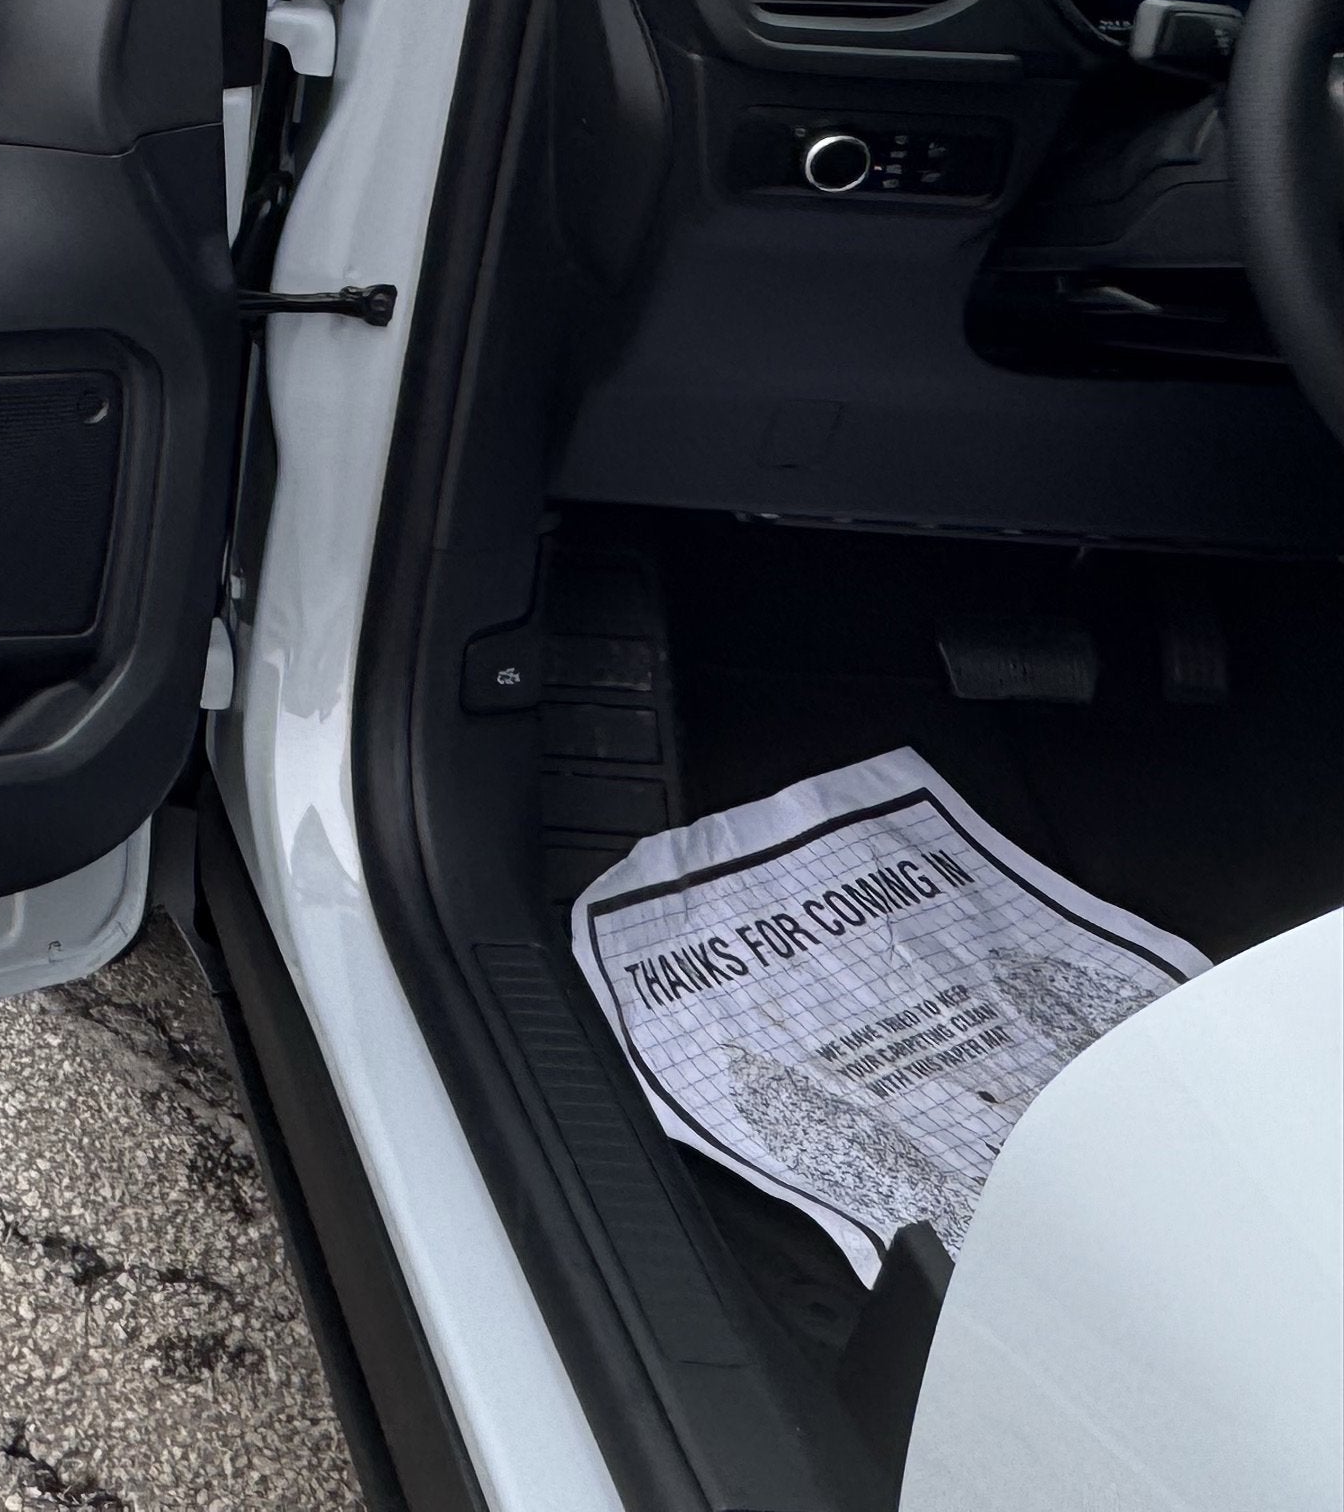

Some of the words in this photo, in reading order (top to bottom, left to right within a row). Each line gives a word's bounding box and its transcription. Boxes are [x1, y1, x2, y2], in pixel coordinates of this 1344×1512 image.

[624, 937, 749, 1010] THANKS
[735, 912, 821, 967] FOR
[802, 859, 944, 937] COMING
[921, 849, 975, 888] IN
[815, 1040, 847, 1063] WE
[839, 1024, 881, 1049] HAVE
[876, 1009, 922, 1034] TRIED
[913, 999, 942, 1019] TO
[836, 1054, 885, 1082] YOUR
[876, 1023, 953, 1063] CARPETING
[950, 1002, 999, 1033] CLEAN
[865, 1068, 913, 1100] WITH
[904, 1056, 943, 1080] THIS
[938, 1038, 989, 1068] PAPER
[978, 1025, 1014, 1050] MAT
